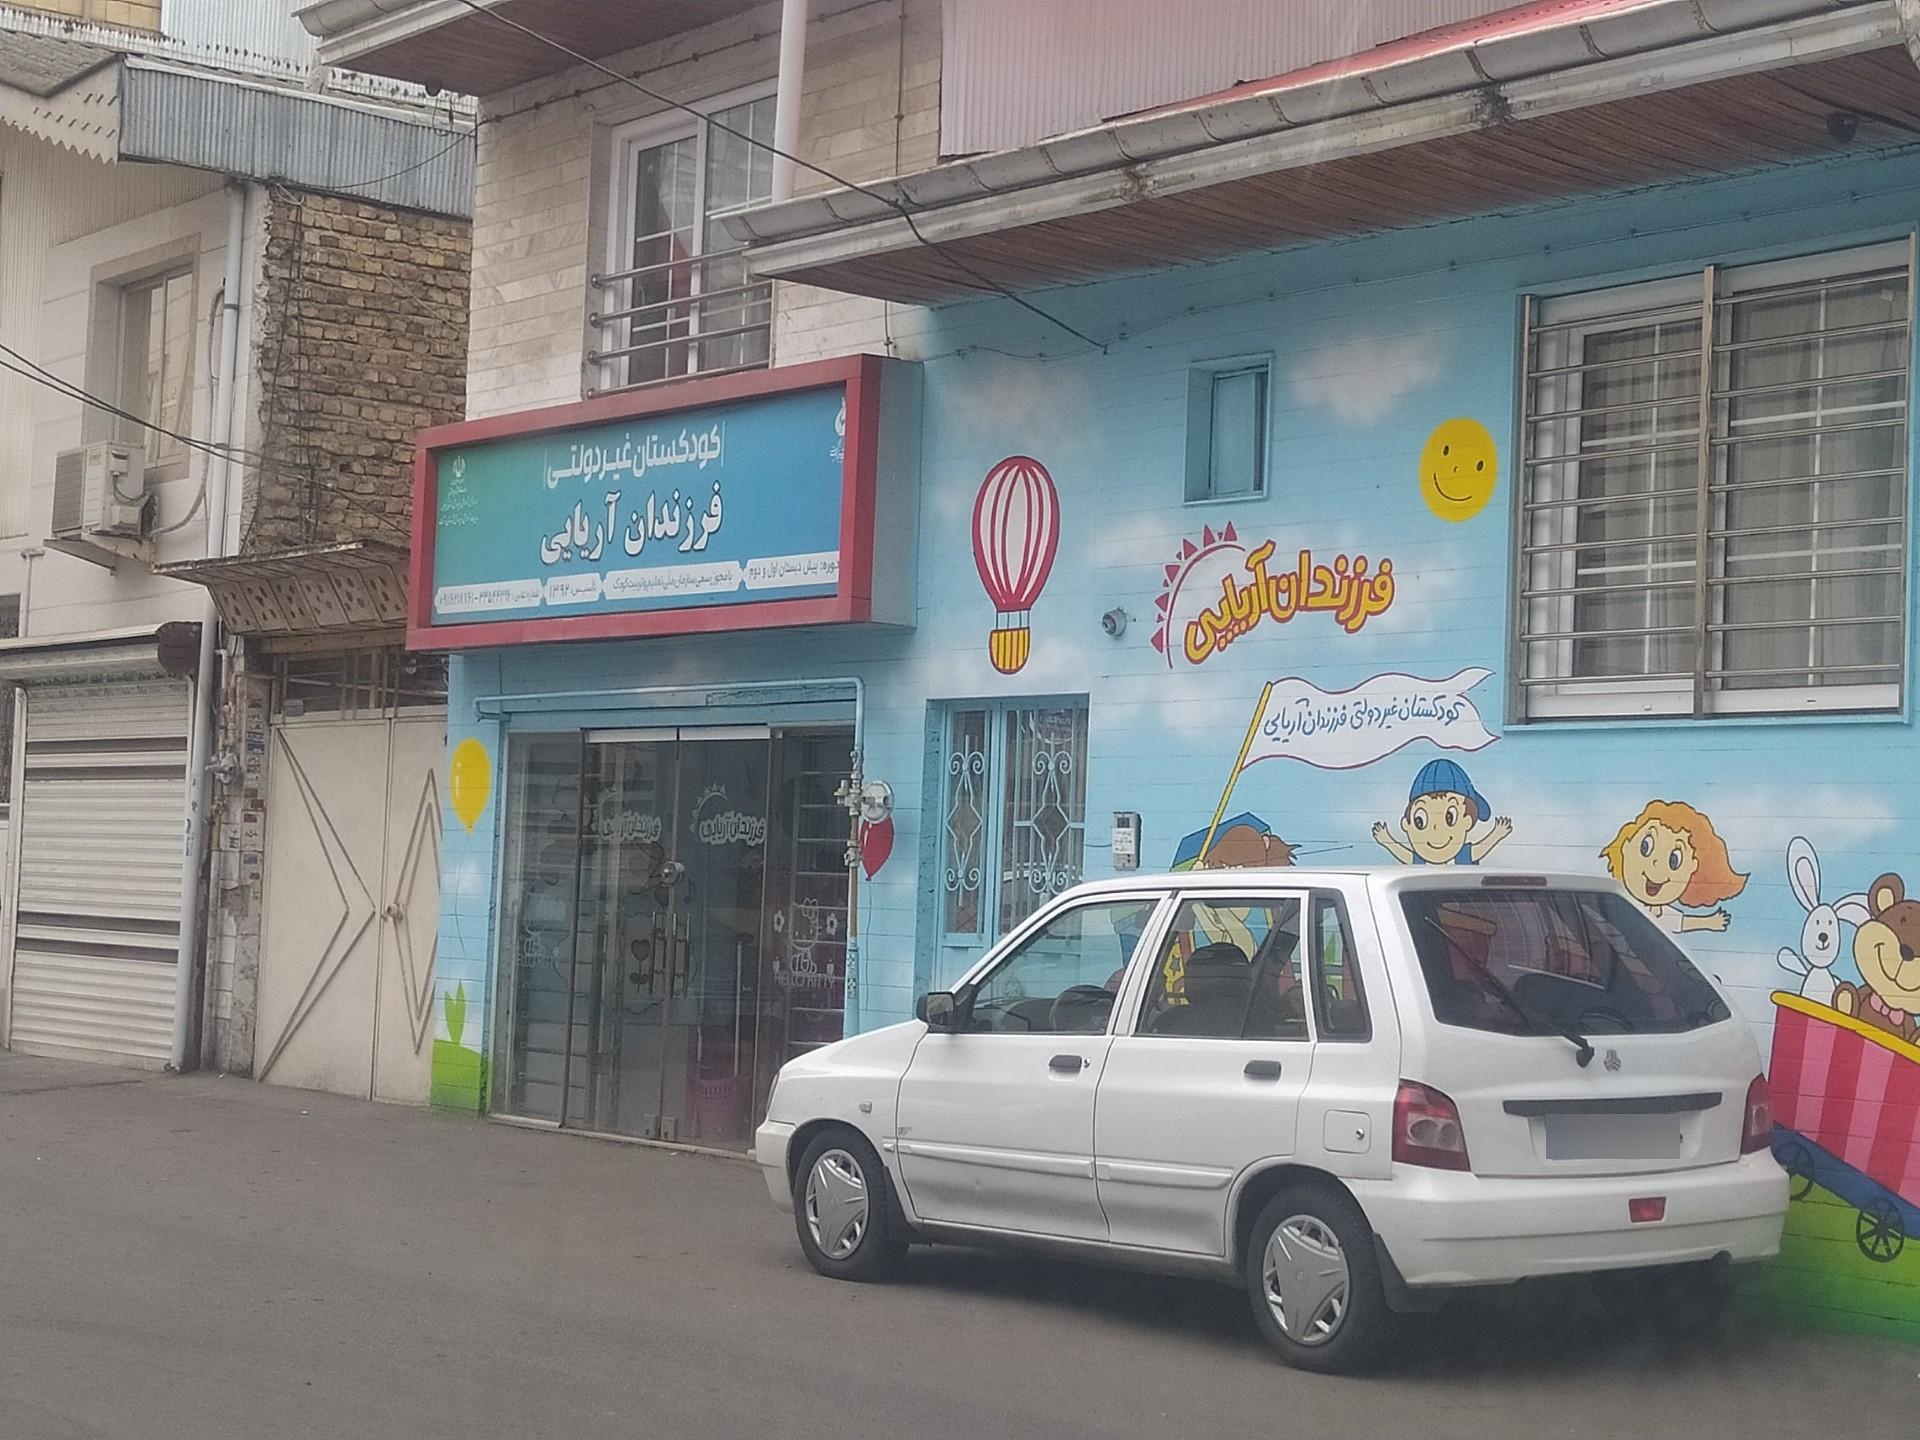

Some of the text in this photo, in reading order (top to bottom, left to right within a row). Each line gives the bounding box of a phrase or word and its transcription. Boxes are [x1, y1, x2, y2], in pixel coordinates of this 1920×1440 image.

[633, 423, 721, 478] کودکستان
[540, 480, 723, 565] فرزندان آریایی
[750, 567, 761, 579] دوم
[768, 561, 778, 578] اول
[779, 561, 802, 577] دبستان
[803, 560, 818, 575] پیش
[1184, 539, 1395, 664] فرزندان آریایی
[1263, 698, 1309, 743] آریایی
[1302, 704, 1347, 735] فرزندان
[1399, 694, 1465, 726] کودکستان
[700, 811, 767, 847] فرزندان آریایی
[774, 970, 835, 989] HELLO KITTY
